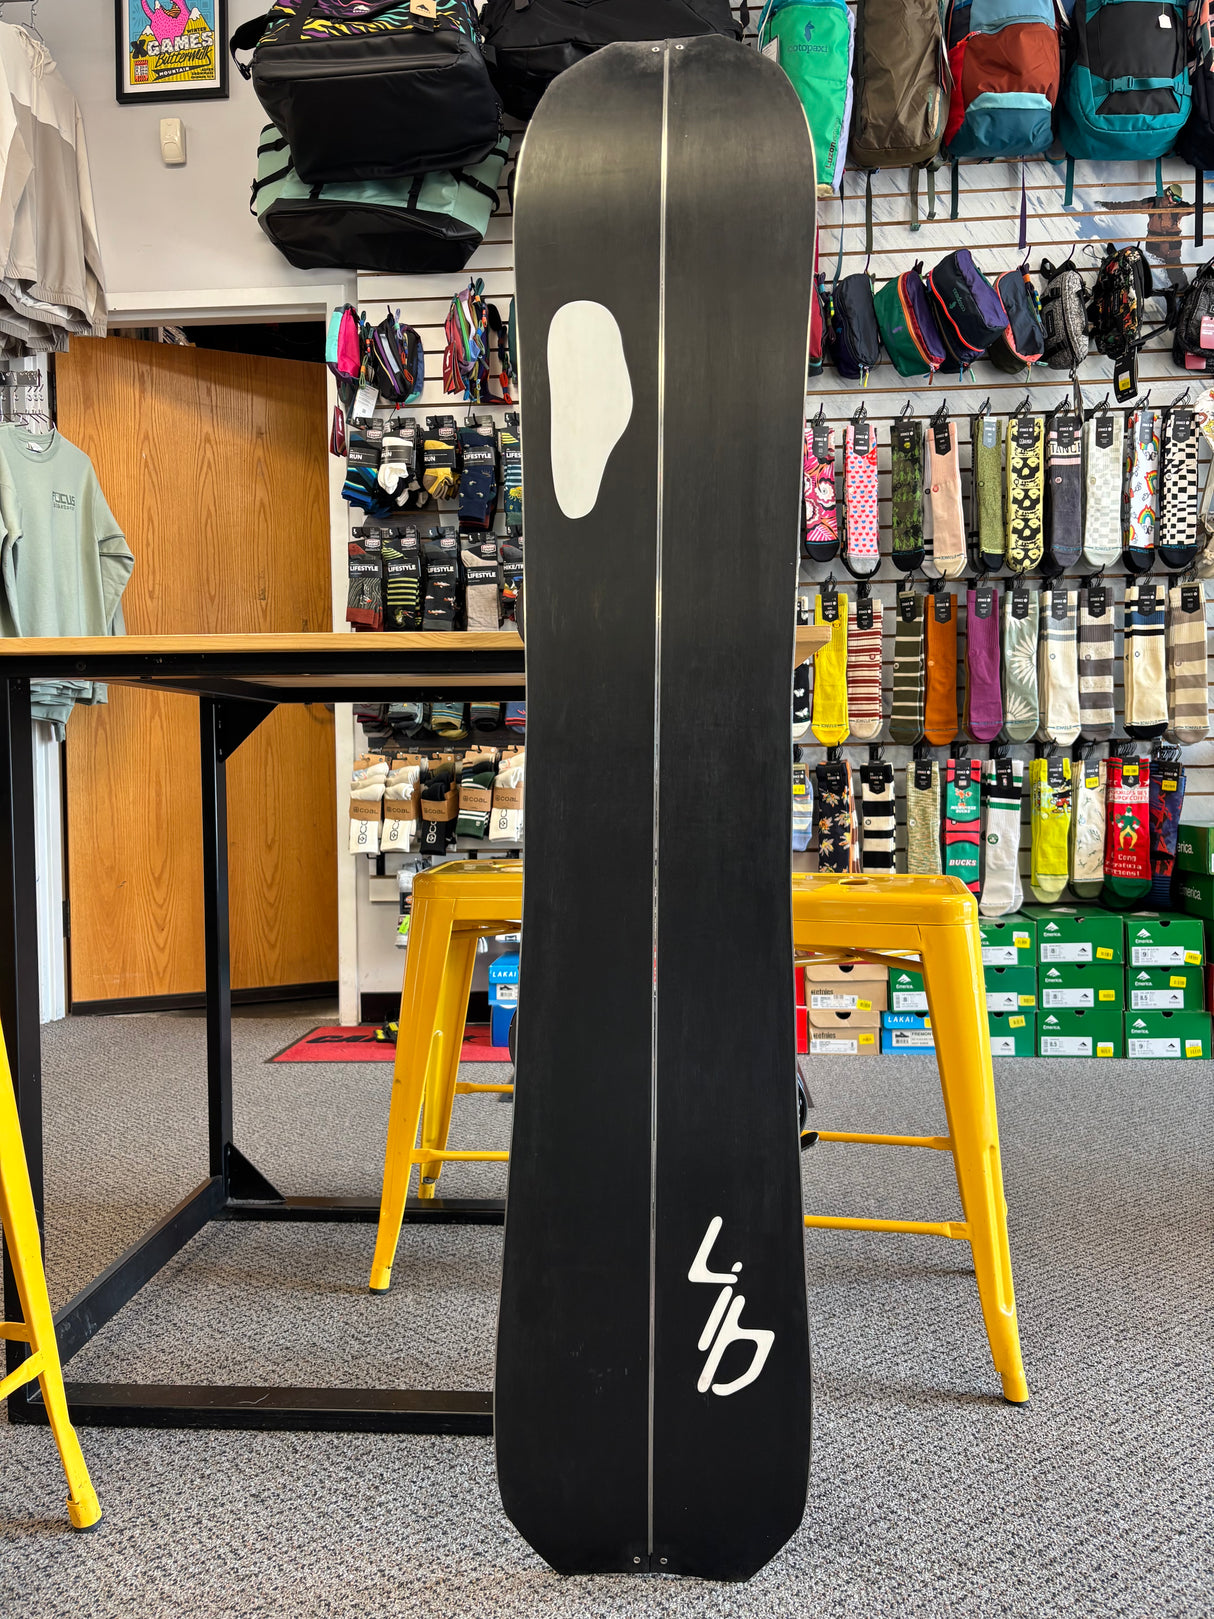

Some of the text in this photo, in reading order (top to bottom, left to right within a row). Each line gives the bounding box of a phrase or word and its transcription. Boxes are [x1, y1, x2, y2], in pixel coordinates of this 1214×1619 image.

[131, 31, 214, 59] X GAMES
[787, 44, 828, 53] cotopaxi
[155, 45, 212, 68] Buttermilk
[159, 67, 190, 76] MOUNTAIN
[825, 142, 837, 168] Luzon
[52, 491, 76, 507] FOCUS
[388, 564, 416, 573] LIFESTYLE
[1178, 841, 1194, 854] erica.
[688, 1216, 776, 1396] Lib
